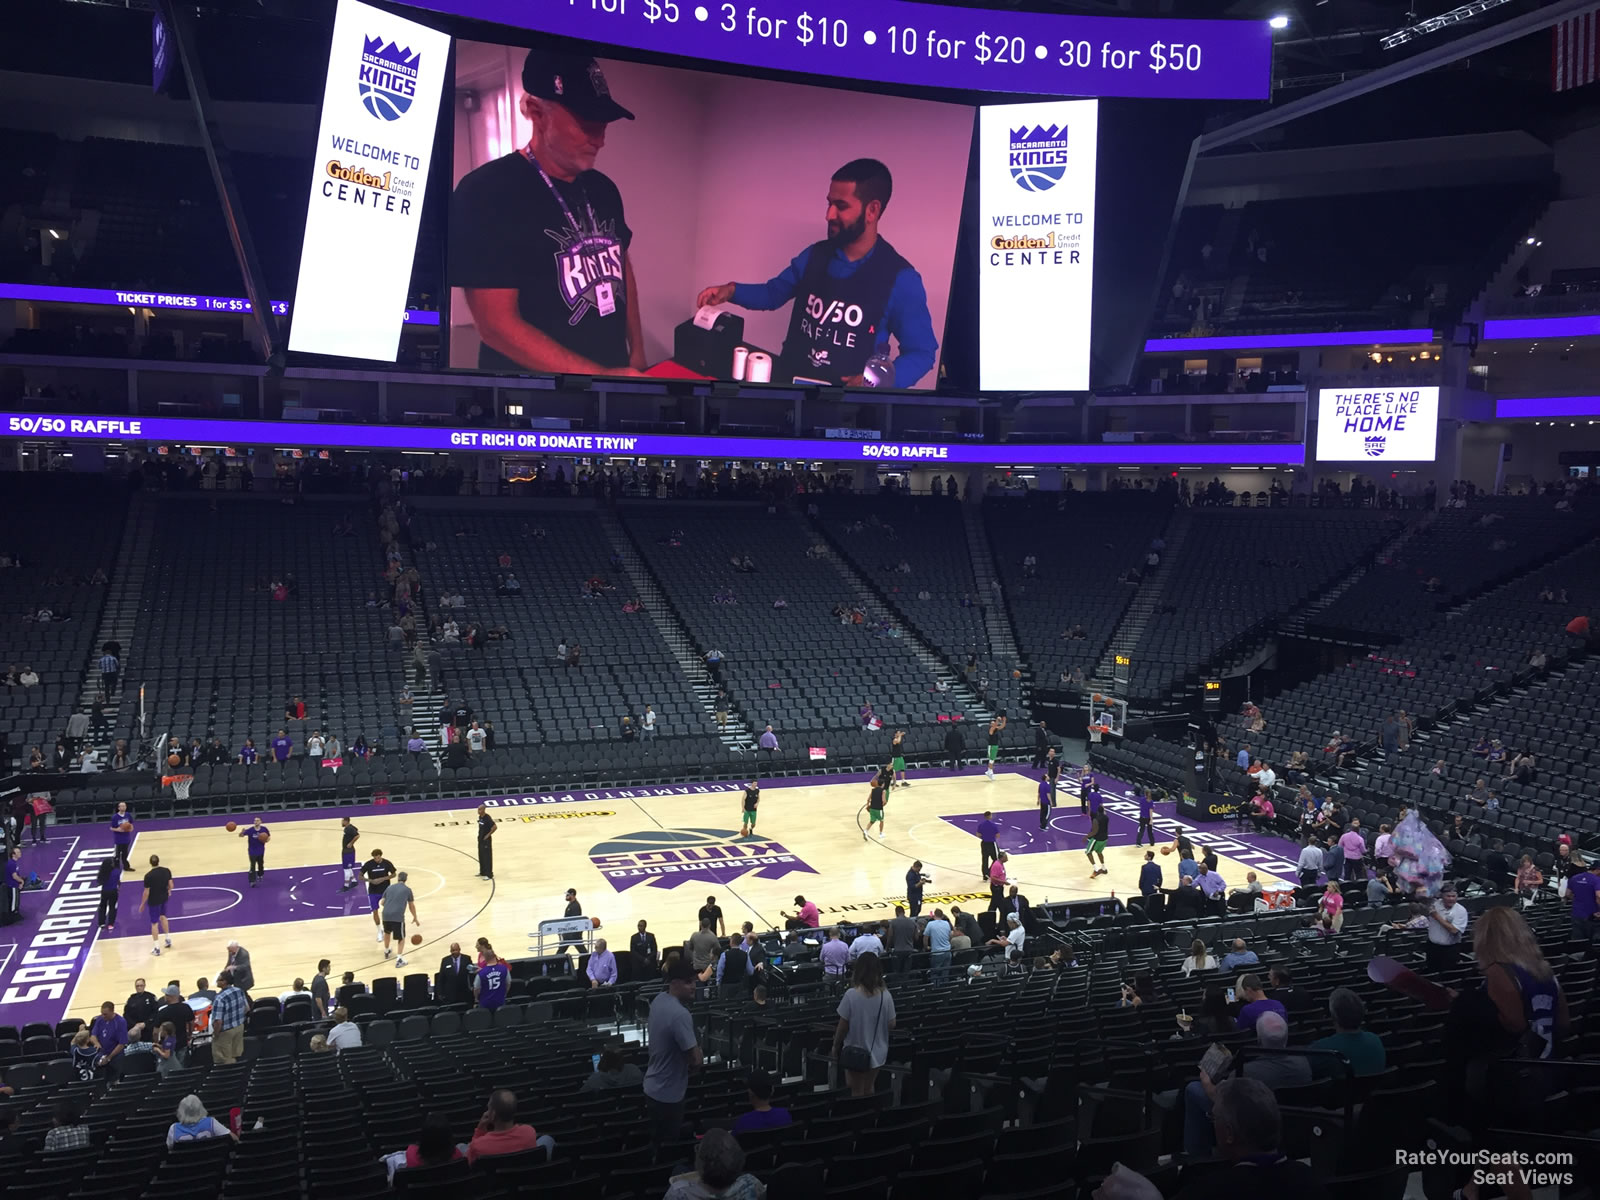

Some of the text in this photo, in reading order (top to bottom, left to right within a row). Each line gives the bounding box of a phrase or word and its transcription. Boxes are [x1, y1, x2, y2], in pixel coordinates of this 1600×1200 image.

[592, 0, 1202, 74] or $5 3 for $10 10 for $20 30 for $50
[363, 52, 417, 77] SACRAMENTO
[359, 64, 417, 97] KINGS
[332, 134, 420, 170] WELCOME TO
[1010, 140, 1067, 149] SACRAMENTO
[1009, 150, 1068, 166] KINGS
[391, 185, 412, 197] Union
[393, 177, 415, 189] Credit
[322, 180, 411, 216] CENTER
[992, 212, 1083, 227] WELCOME TO
[1057, 233, 1081, 241] Credit
[1057, 241, 1080, 249] Union
[990, 250, 1081, 266] CENTER
[563, 244, 622, 299] KINGS
[116, 292, 243, 311] TICKET PRICES 1 for $5
[805, 293, 863, 327] 50/50
[800, 318, 857, 348] RAFLE
[1336, 391, 1420, 405] THERE'S NO
[1336, 403, 1419, 416] PLACE LIKE
[9, 417, 142, 435] 50/50 RAFFLE
[1344, 415, 1408, 433] HOME
[451, 432, 638, 450] GET RICH OR DONATE TRYIN'
[862, 444, 948, 459] 50/50 RAFFLE
[483, 794, 574, 807] PROUD
[434, 817, 516, 828] CETER
[589, 842, 792, 869] KINGS
[608, 855, 796, 878] SACRAMENTO
[488, 977, 501, 990] 15
